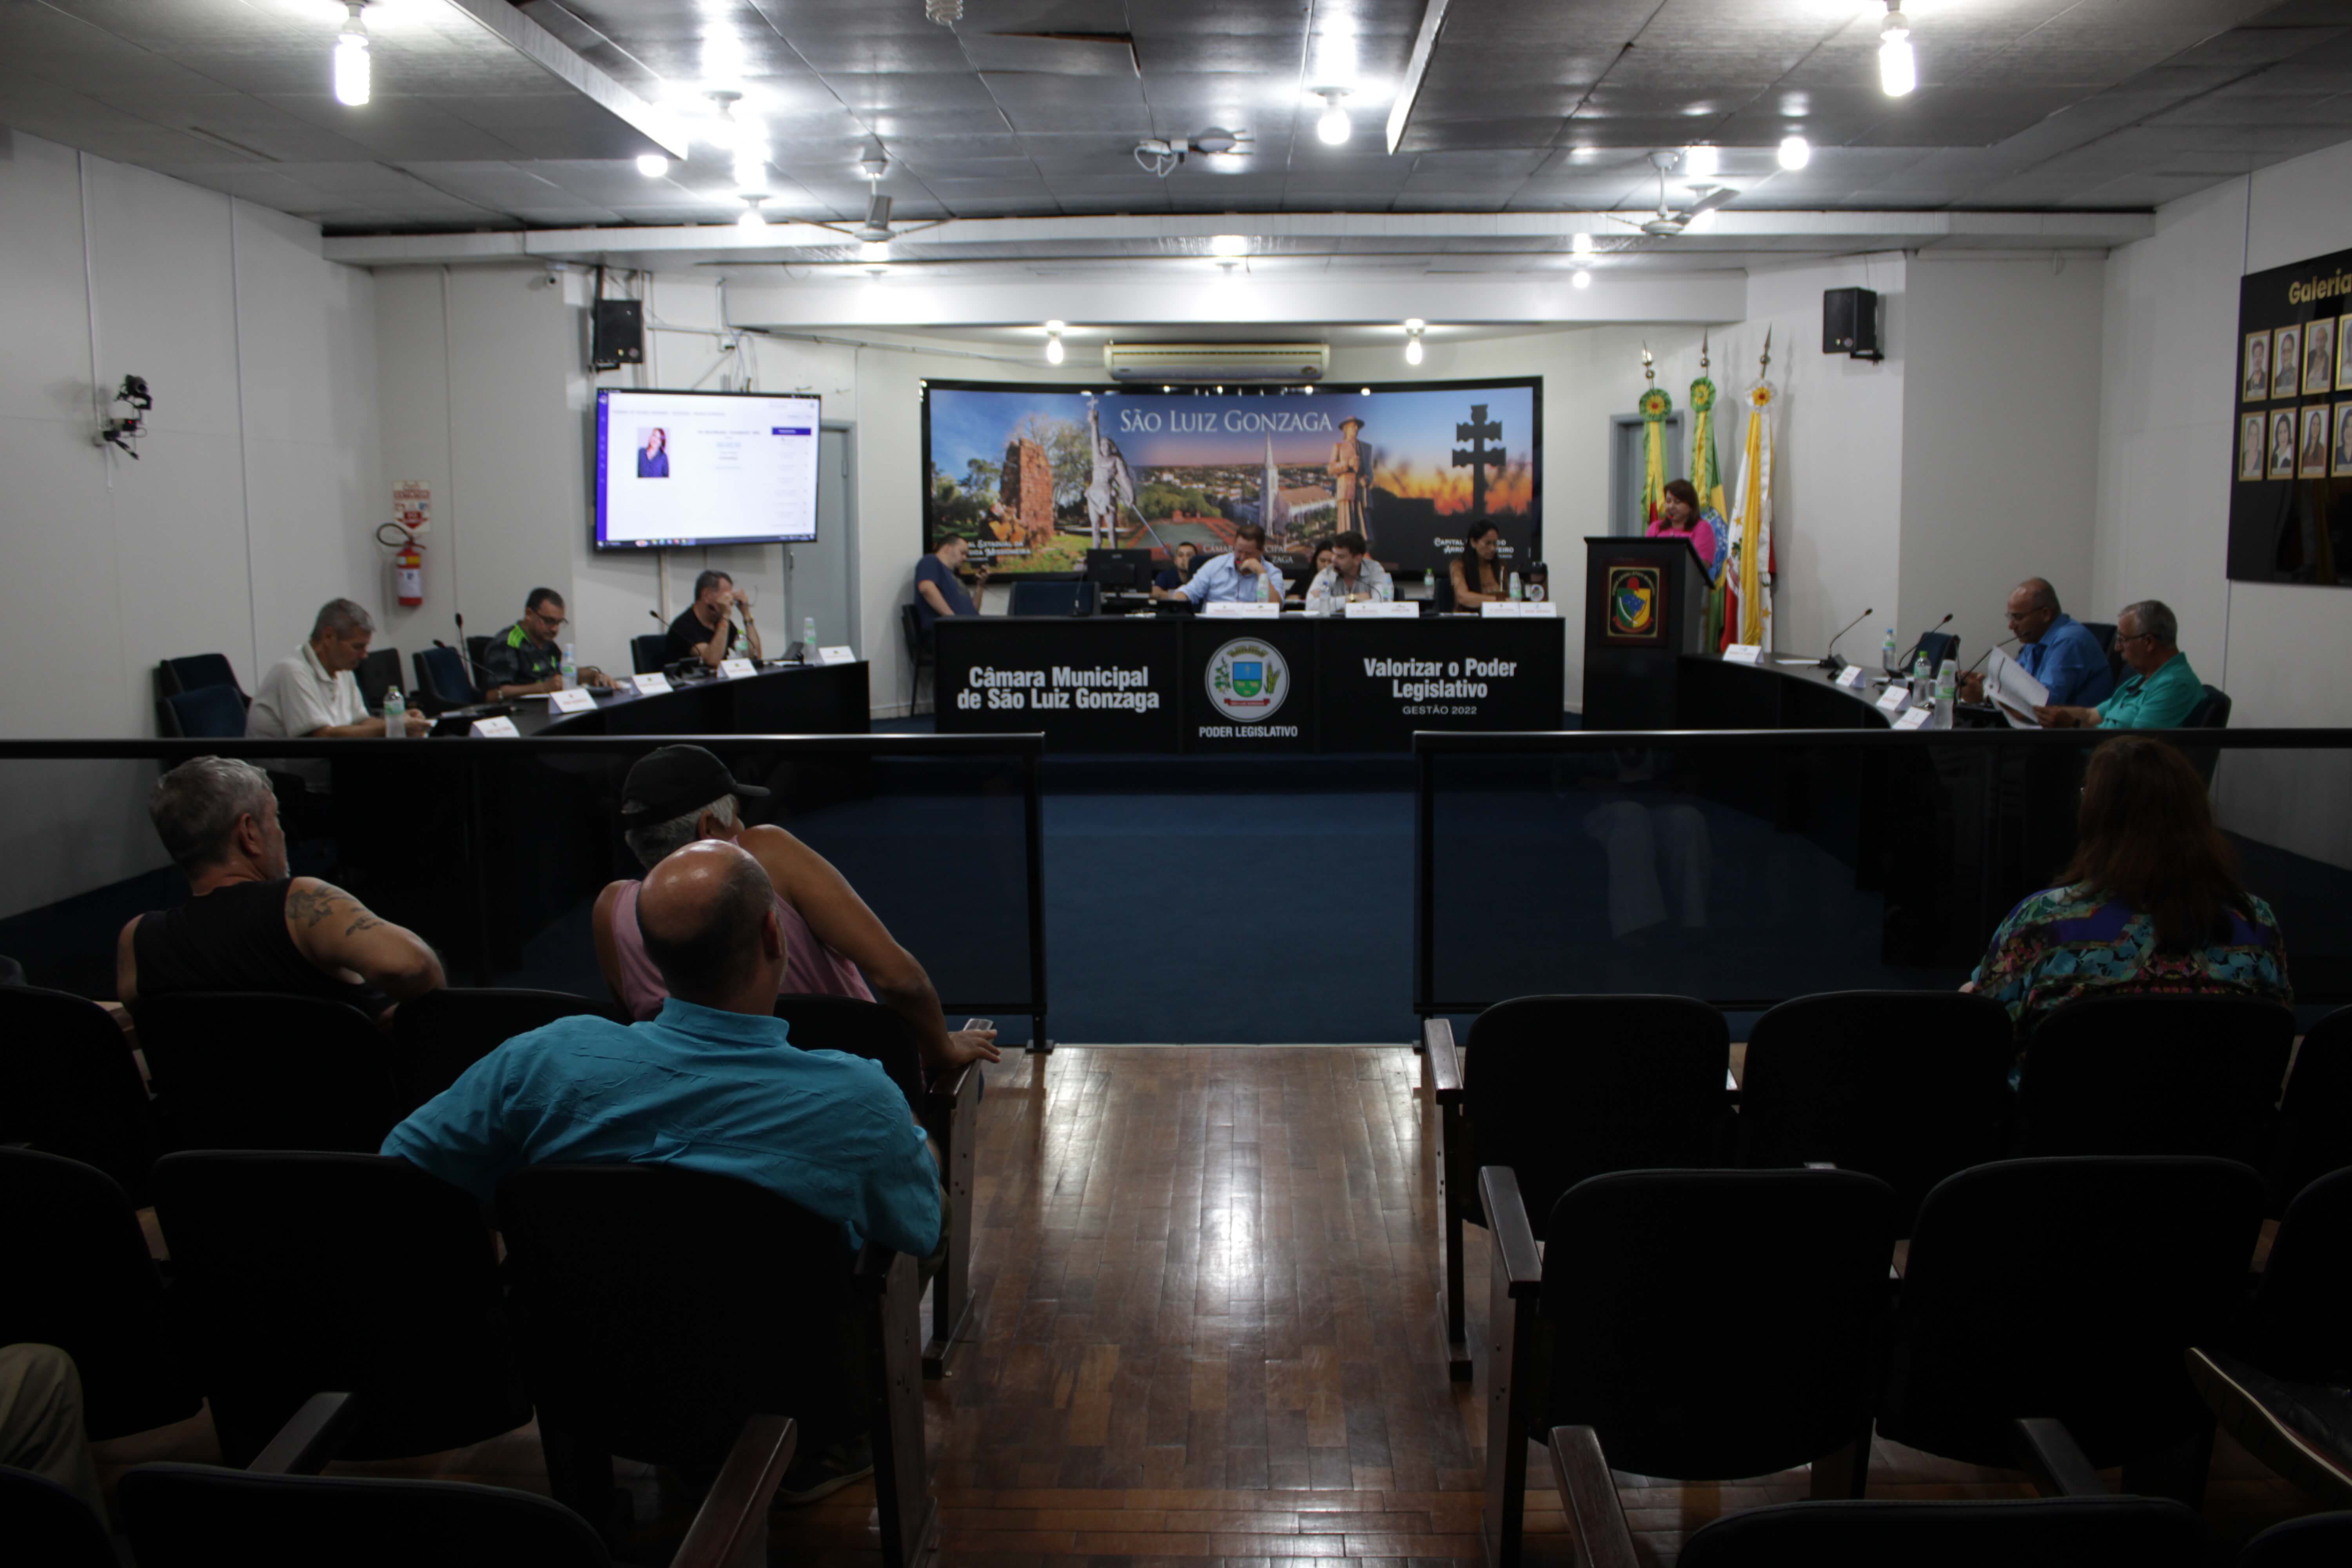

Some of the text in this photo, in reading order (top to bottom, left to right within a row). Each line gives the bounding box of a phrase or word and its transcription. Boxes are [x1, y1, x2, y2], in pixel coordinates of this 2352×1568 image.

[2288, 268, 2352, 305] Galeria
[1120, 409, 1332, 432] SÃO LUIZ GONZAGA
[969, 666, 1149, 691] Câmara Municipal
[1363, 658, 1517, 677] Valorizar o Poder
[957, 687, 1160, 713] de São Luiz Gonzaga
[1392, 679, 1488, 702] Legislativo
[1402, 704, 1477, 715] GESTÃO 2022
[1199, 726, 1298, 738] PODER LEGISLATIVO
